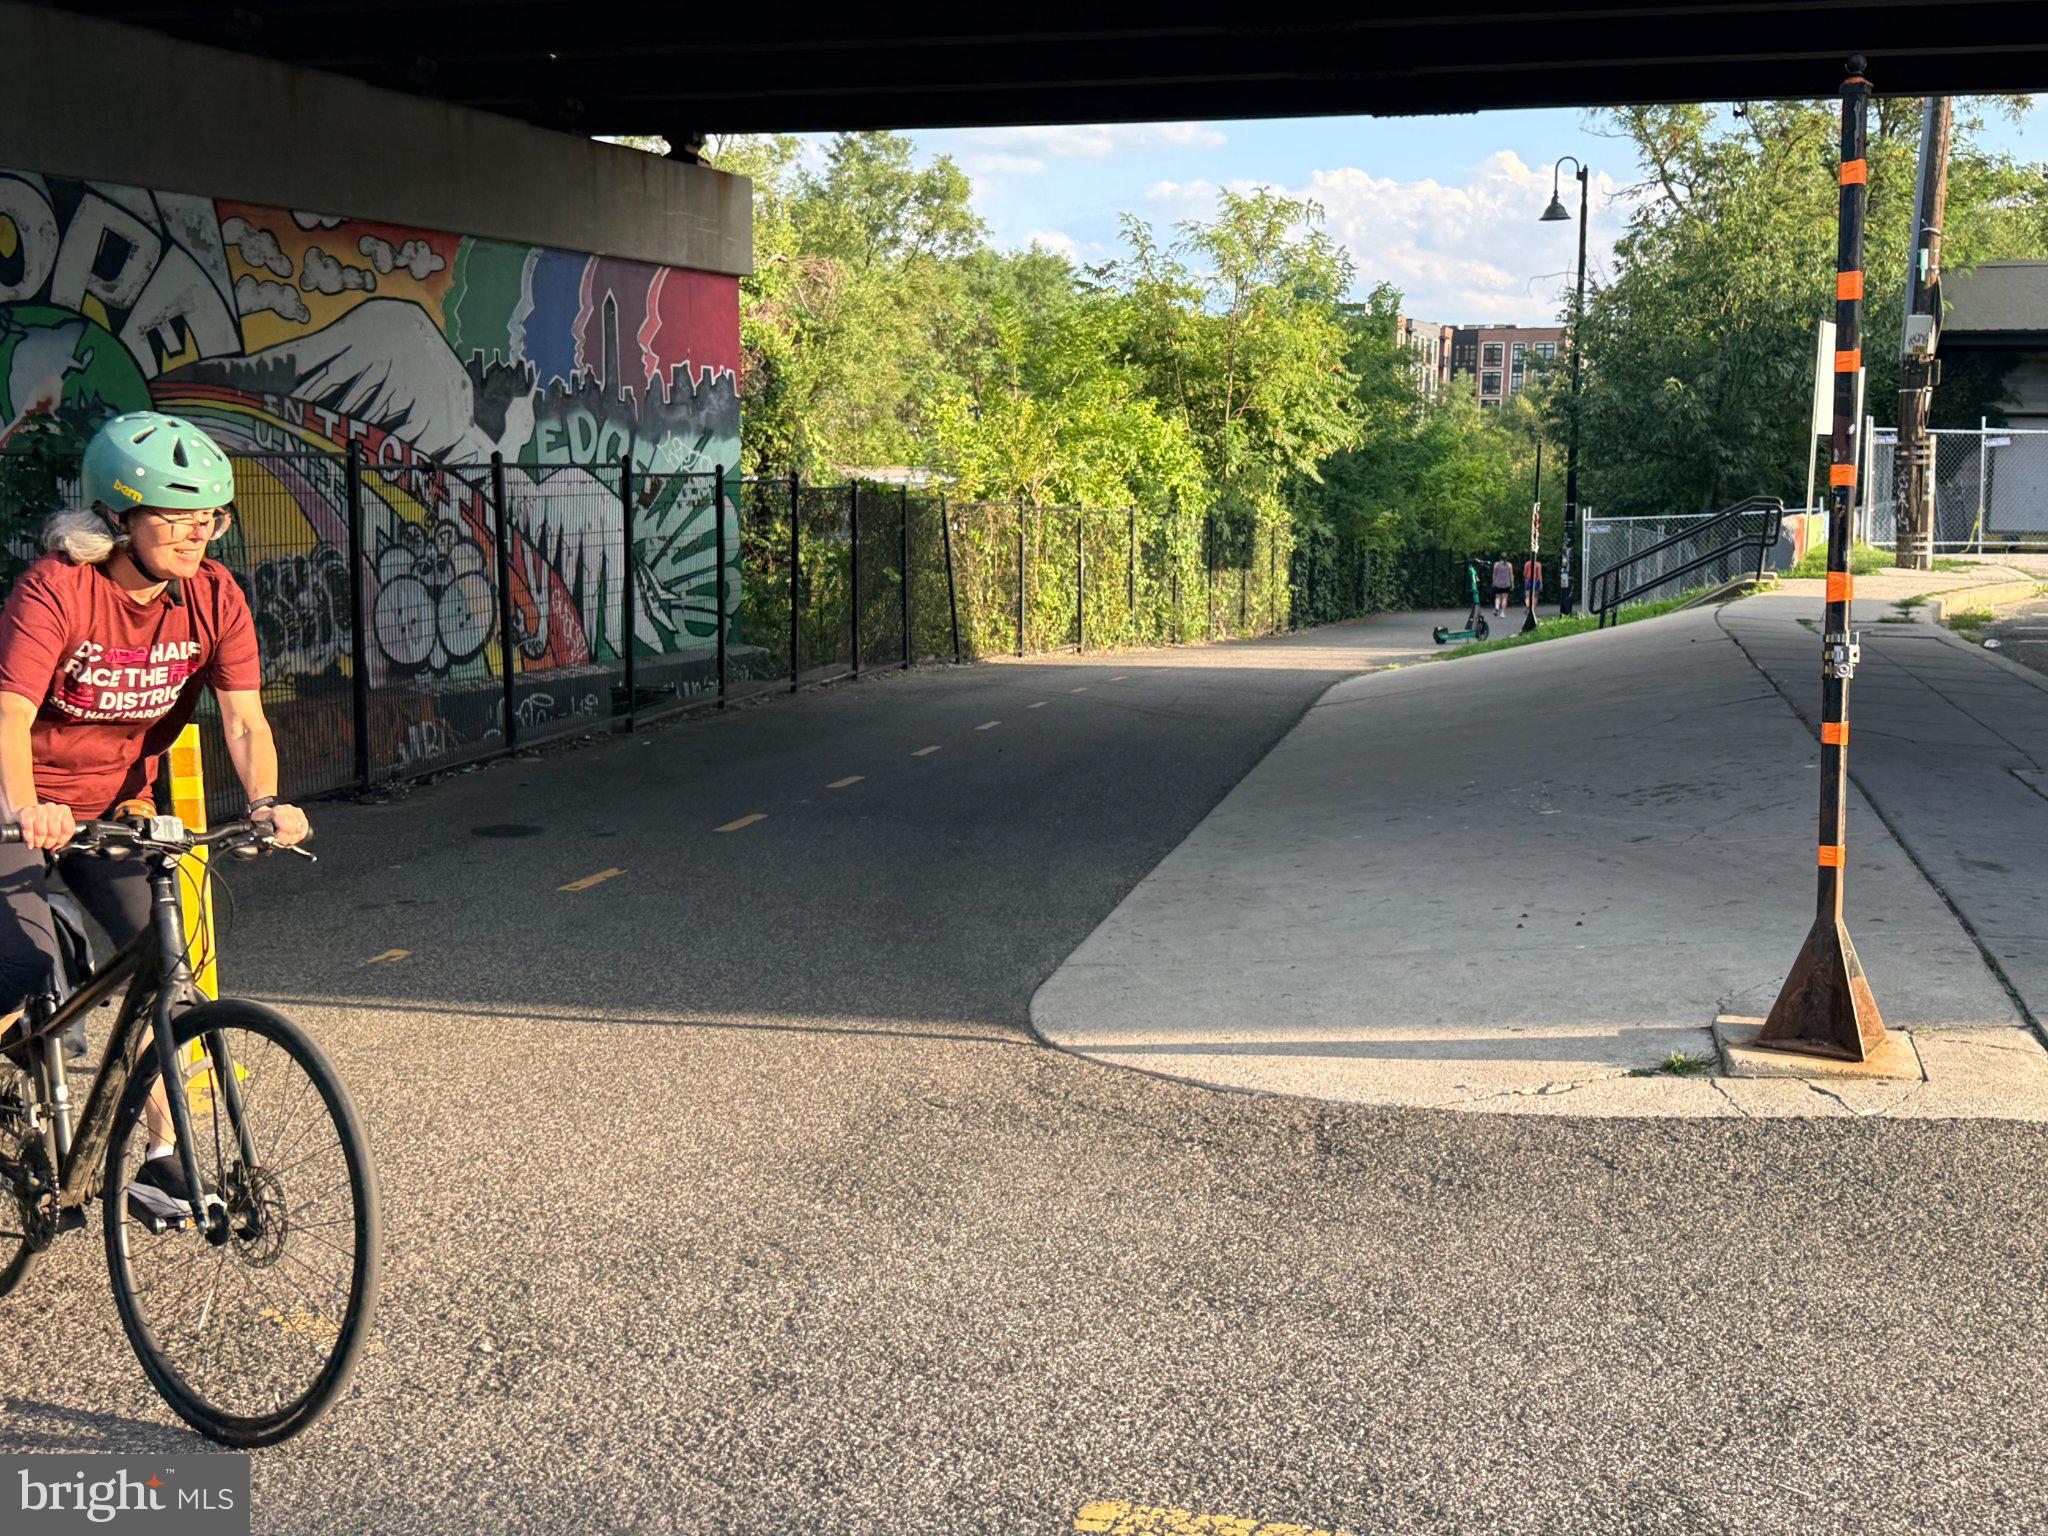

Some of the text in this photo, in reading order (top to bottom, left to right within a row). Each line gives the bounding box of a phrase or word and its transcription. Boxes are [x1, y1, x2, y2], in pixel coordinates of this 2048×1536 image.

[74, 640, 202, 663] DC HALF
[64, 658, 170, 688] RACE THE
[50, 695, 84, 717] 2025
[83, 710, 123, 721] HALF
